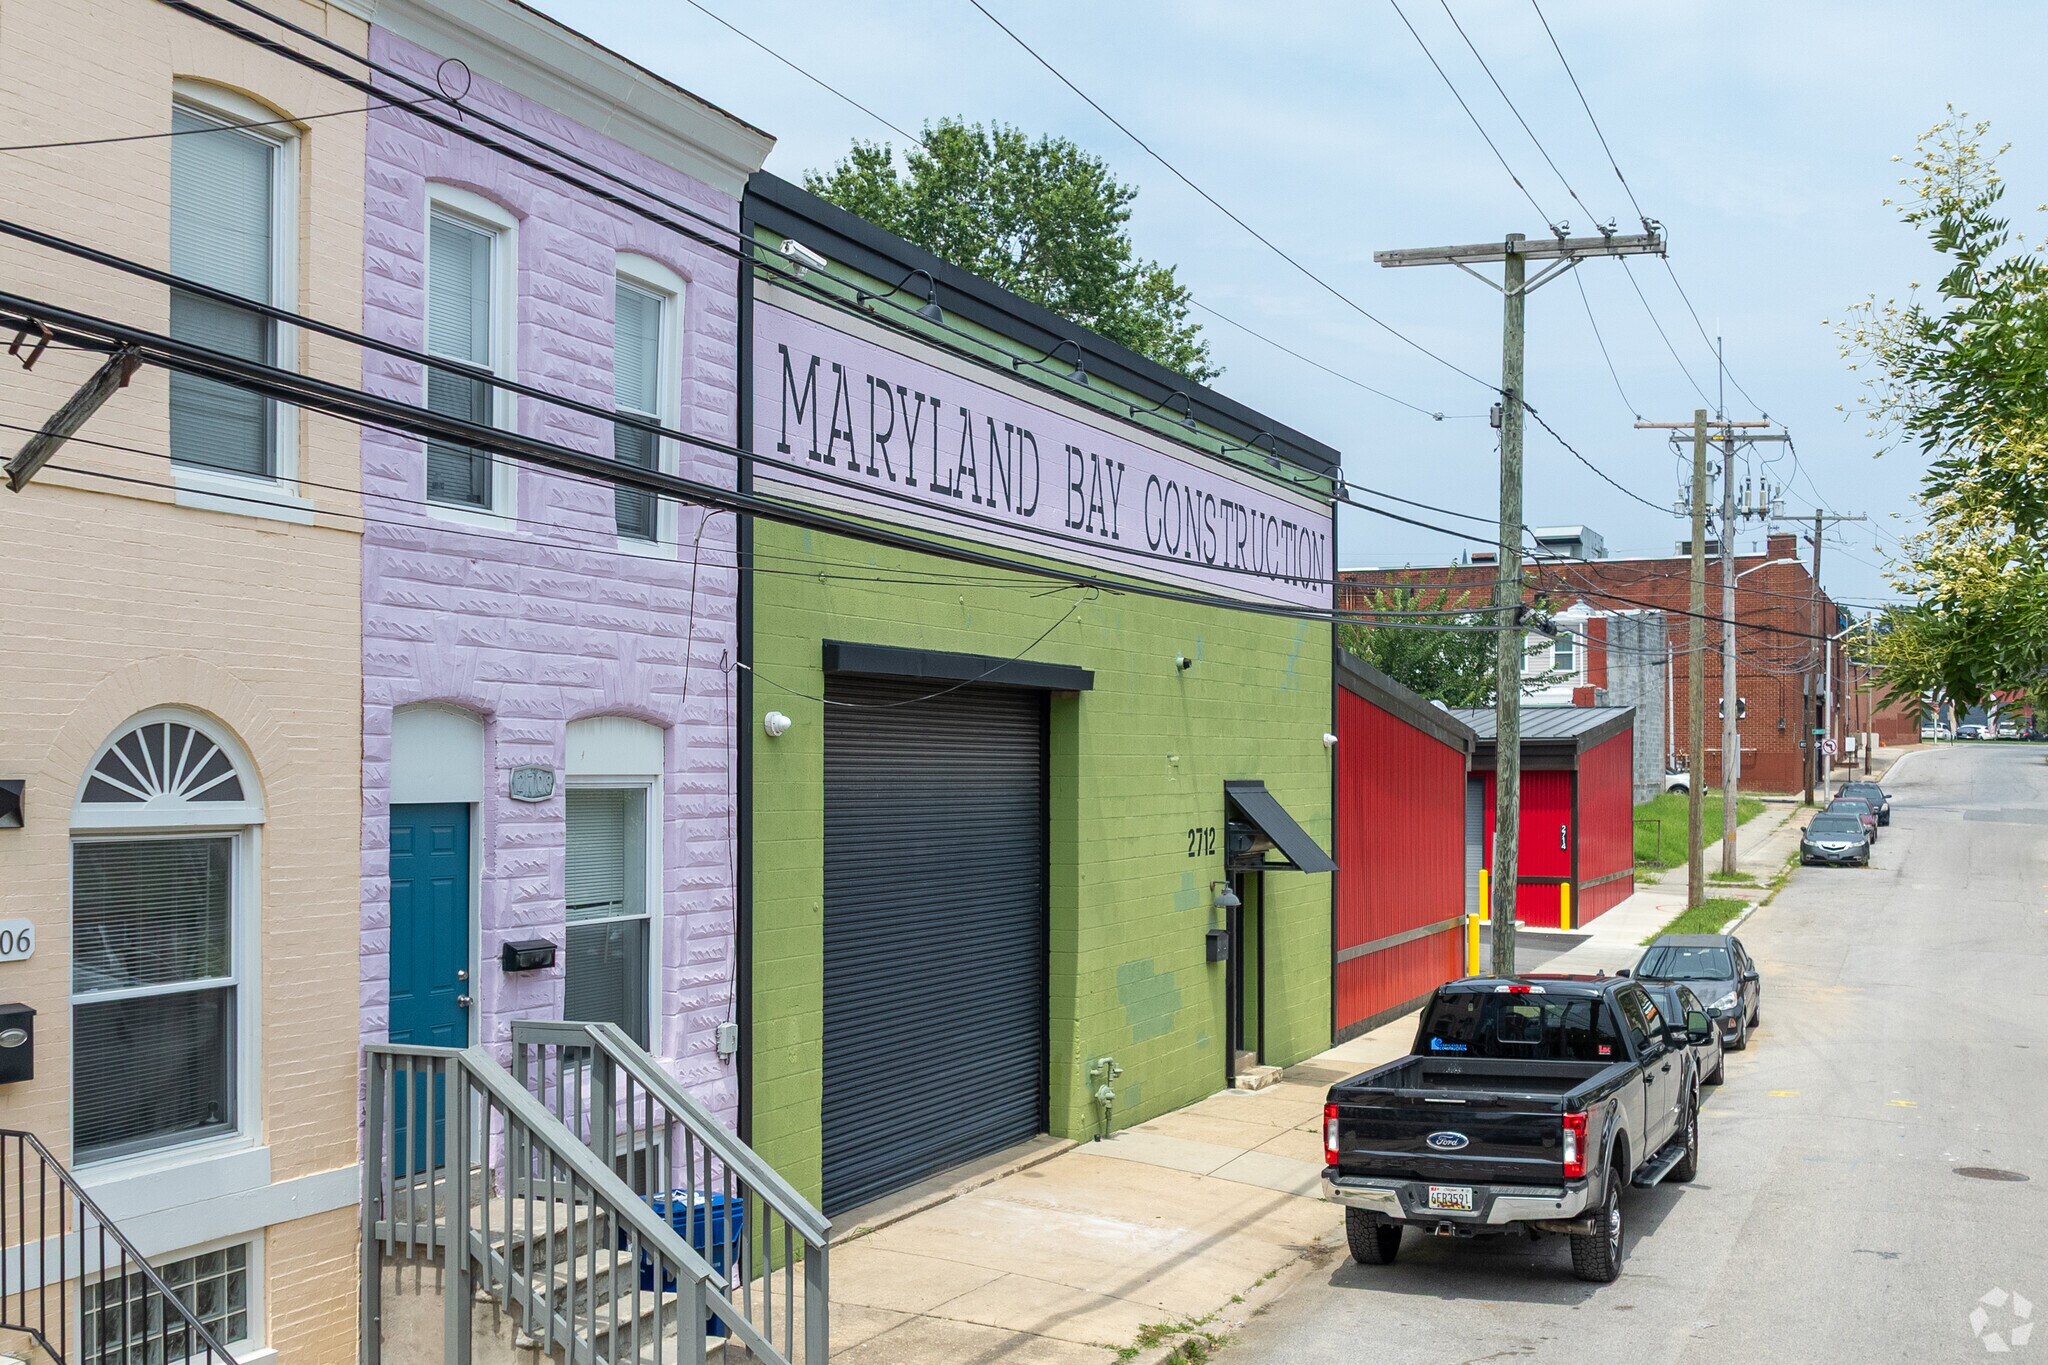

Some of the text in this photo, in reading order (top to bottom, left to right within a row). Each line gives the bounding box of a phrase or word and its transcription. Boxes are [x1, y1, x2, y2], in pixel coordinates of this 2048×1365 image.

[777, 343, 1326, 594] MARYLAND BAY CONSTRUCTION
[1187, 827, 1216, 858] 2712
[0, 928, 31, 955] 06
[1436, 1135, 1459, 1146] Ford
[1431, 1192, 1469, 1204] 6ER3591
